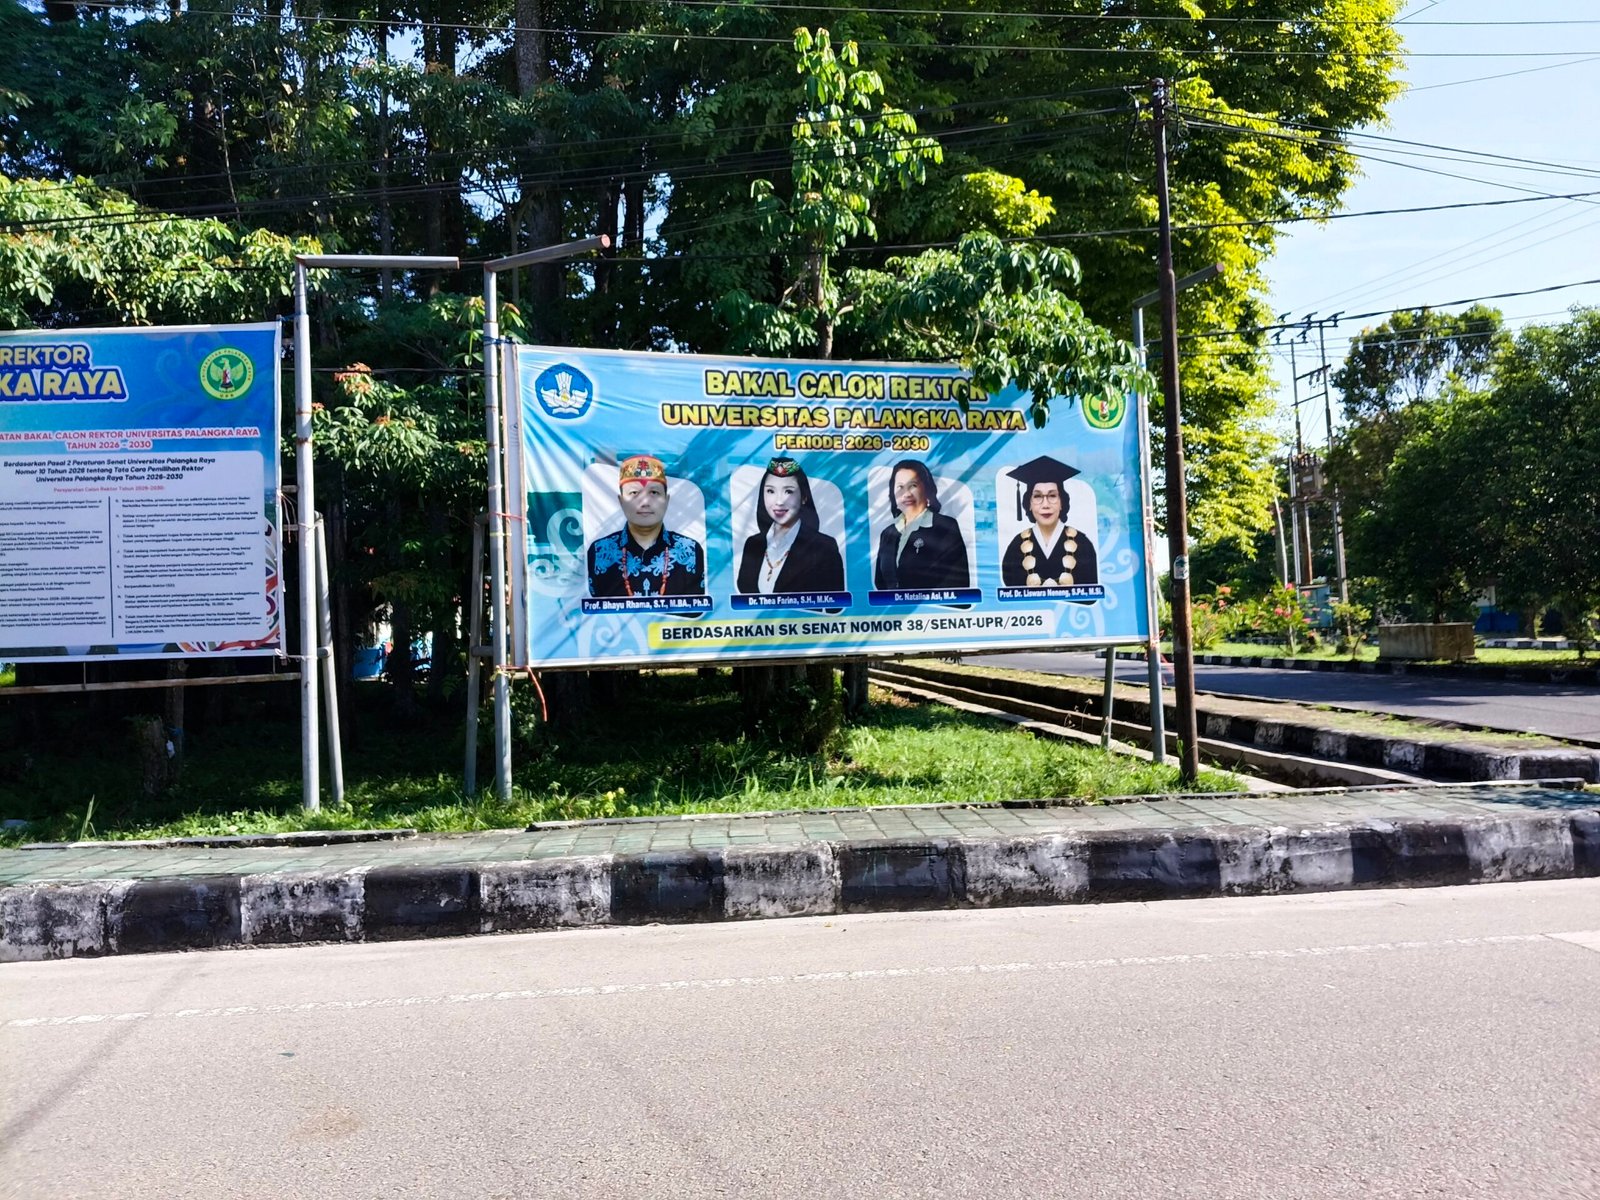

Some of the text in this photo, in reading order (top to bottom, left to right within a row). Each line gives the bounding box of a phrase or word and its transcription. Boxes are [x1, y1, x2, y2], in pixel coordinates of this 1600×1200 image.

[0, 345, 88, 366] REKTOR
[42, 370, 123, 396] RAYA
[705, 370, 796, 397] BAKAL
[798, 373, 884, 400] CALON
[662, 404, 1027, 431] UNIVERSITAS PALANGKA RAYA
[24, 432, 52, 440] BAKAL
[55, 431, 86, 439] CALON
[125, 429, 182, 438] UNIVERSITAS
[185, 428, 234, 437] PALANGKA
[236, 428, 259, 436] RAYA
[67, 441, 96, 450] TAHUN
[99, 440, 120, 449] 2026
[129, 440, 151, 448] 2030
[775, 434, 843, 449] PERIODE
[844, 435, 882, 449] 2026
[891, 435, 929, 450] 2030
[166, 457, 198, 465] Palangka
[199, 456, 216, 464] Raya
[74, 475, 106, 483] Palangka
[106, 474, 124, 482] Raya
[894, 592, 904, 601] Dr.
[943, 591, 957, 599] M.A.
[1000, 590, 1013, 598] Prof.
[1014, 590, 1022, 598] Dr.
[584, 602, 602, 610] Prof.
[602, 600, 625, 611] Bhayu
[625, 600, 652, 609] Rhama,
[653, 599, 669, 609] S.T.,
[692, 598, 711, 607] Ph.D.
[748, 597, 758, 606] Dr.
[759, 597, 776, 605] Thea
[777, 596, 800, 605] Farina,
[662, 615, 1043, 640] BERDASARKAN SK SENAT NOMOR 38/SENAT-UPR/2026
